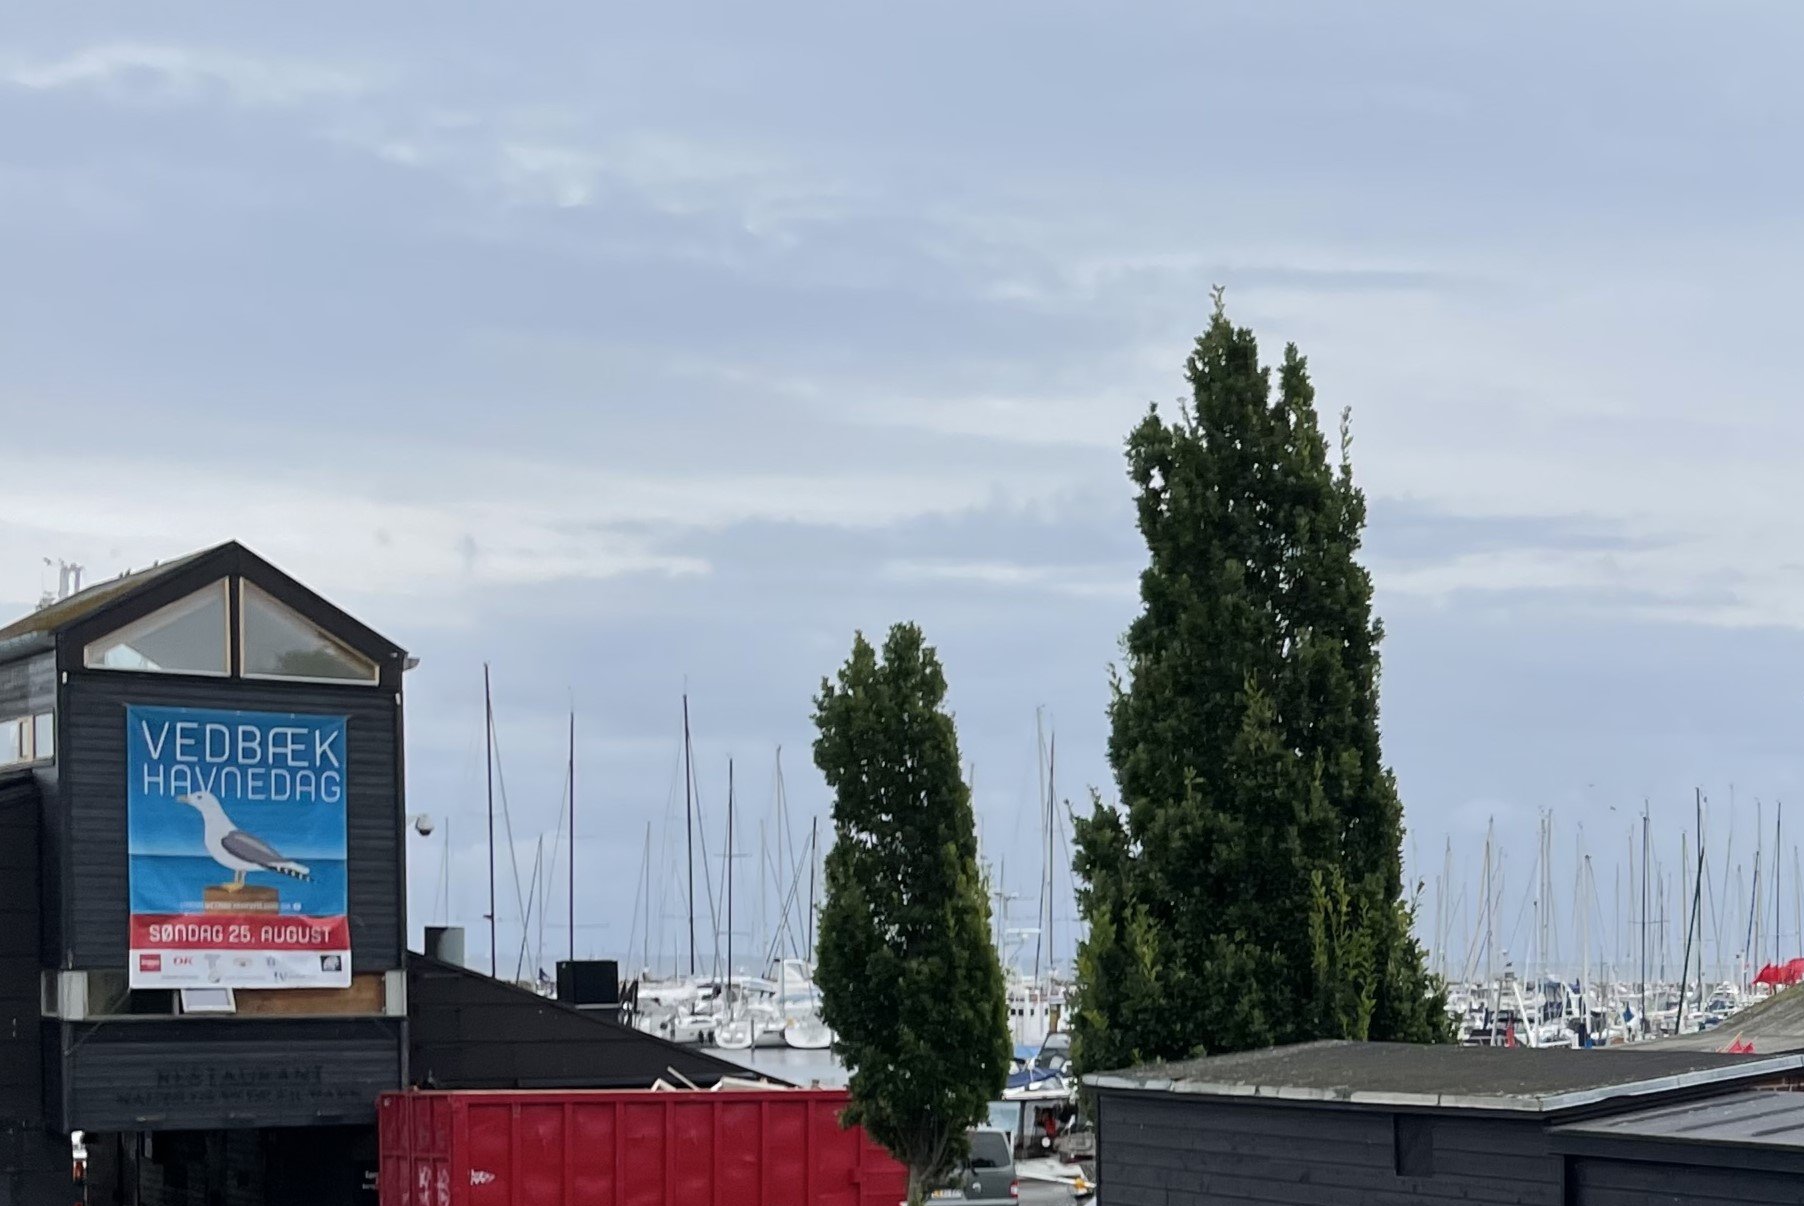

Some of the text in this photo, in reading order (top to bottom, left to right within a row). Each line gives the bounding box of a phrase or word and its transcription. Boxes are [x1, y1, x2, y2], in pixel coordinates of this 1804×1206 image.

[142, 719, 340, 768] VEDBÆK
[143, 763, 341, 803] HAVNEDAG
[149, 923, 224, 943] SØNDAG
[261, 926, 332, 945] AUGUST
